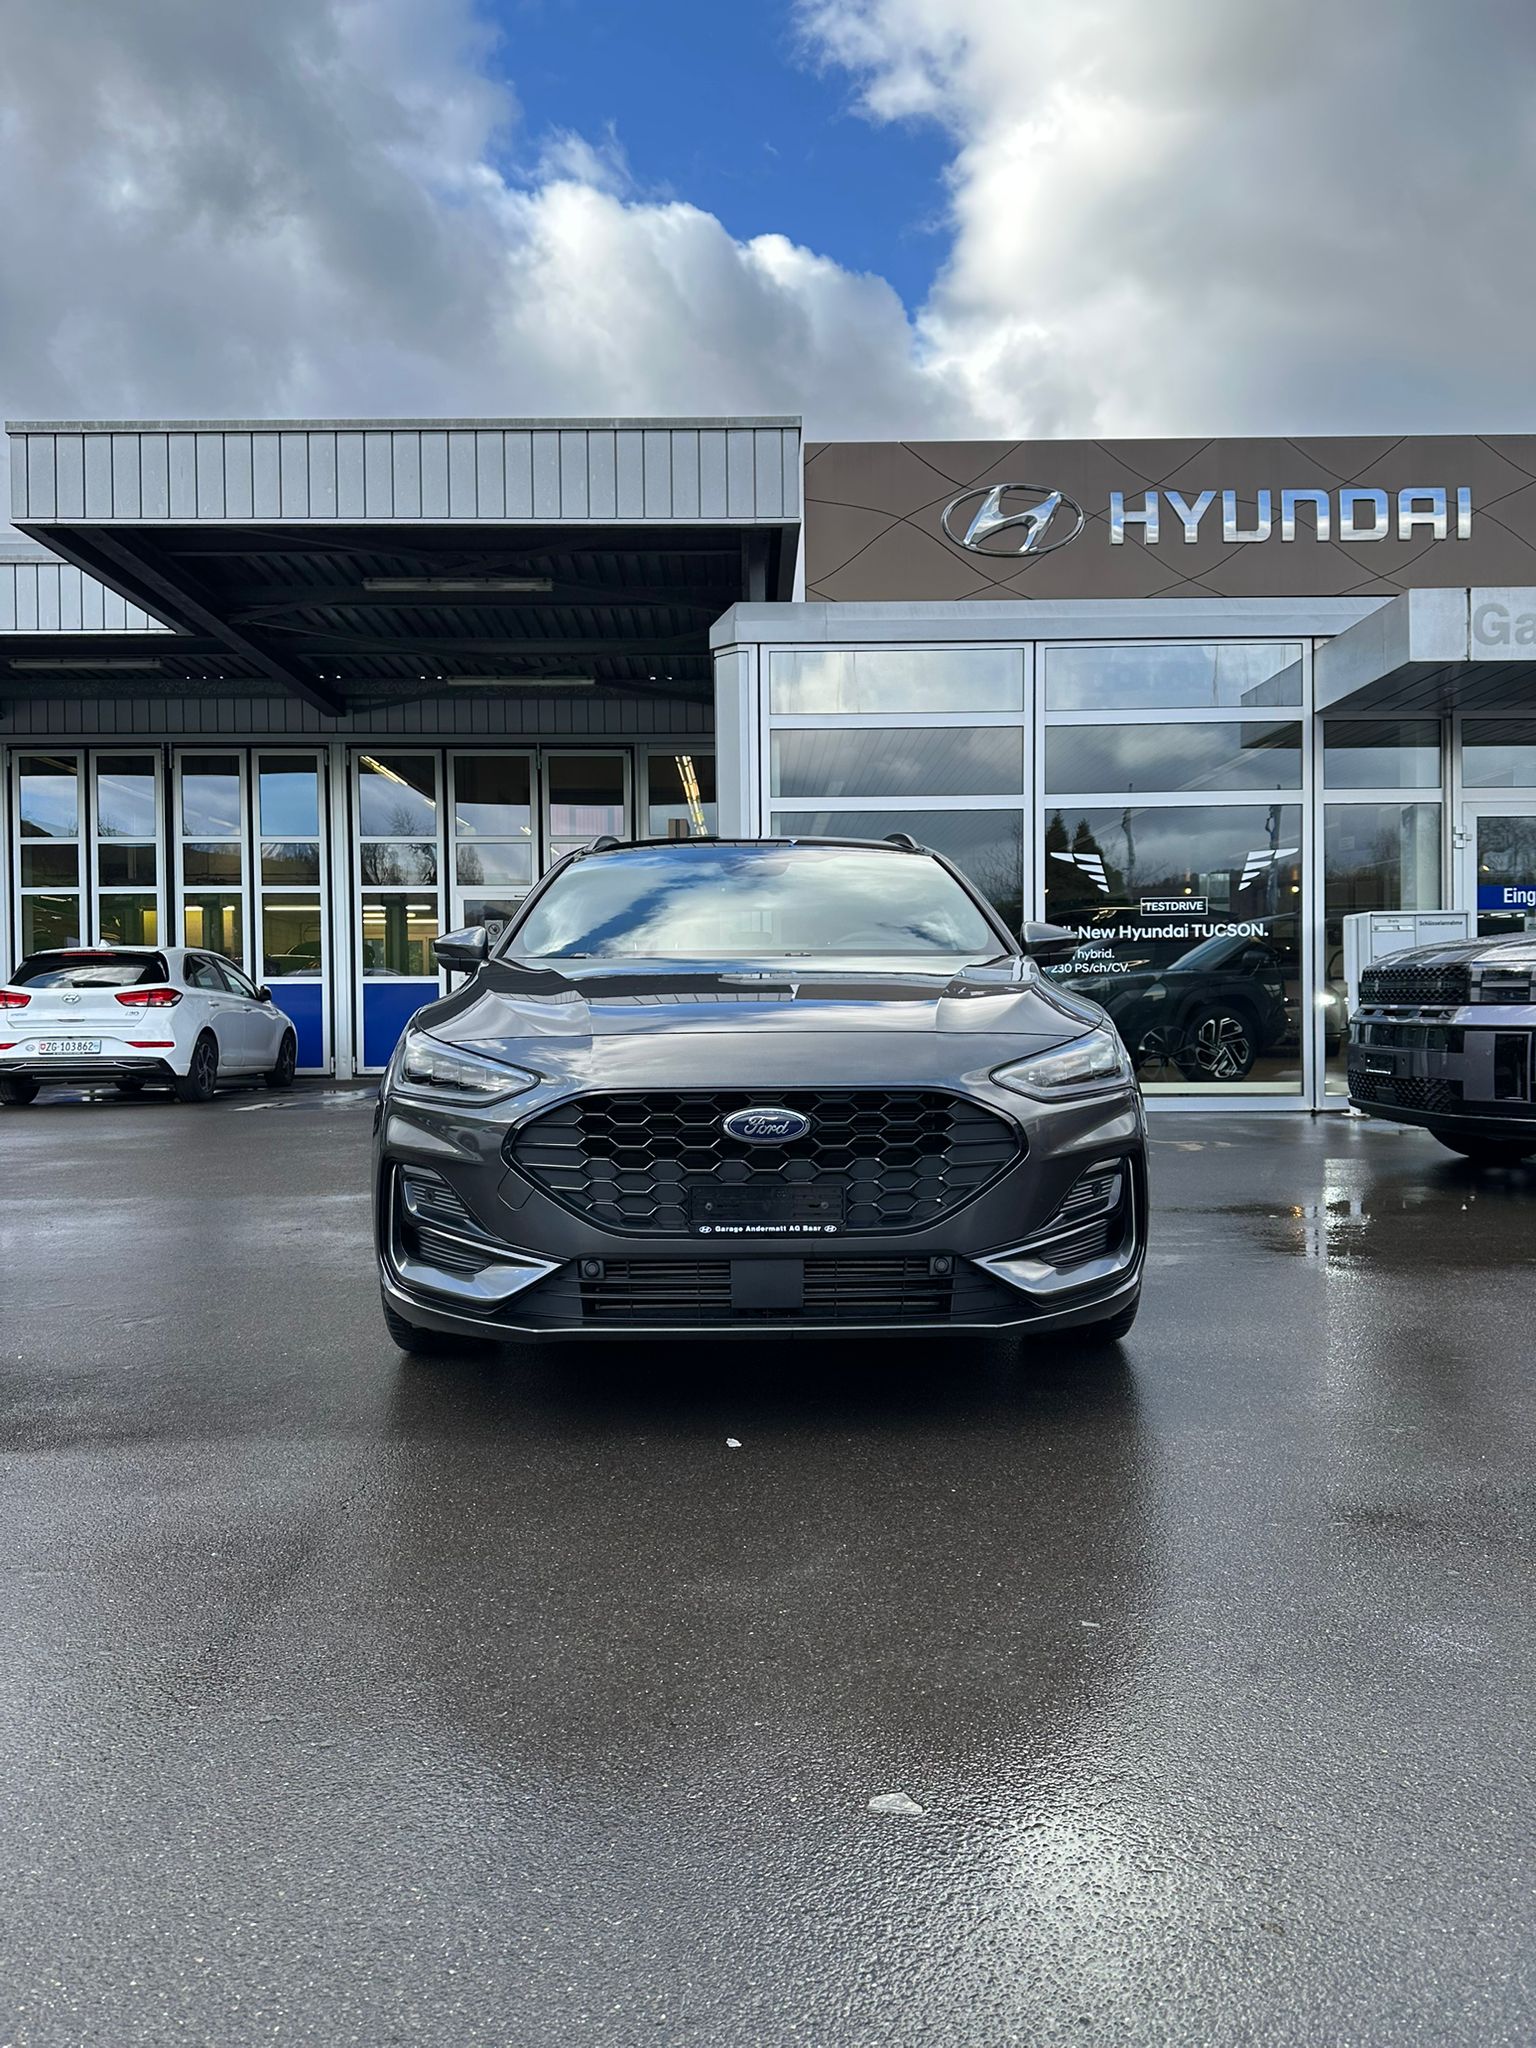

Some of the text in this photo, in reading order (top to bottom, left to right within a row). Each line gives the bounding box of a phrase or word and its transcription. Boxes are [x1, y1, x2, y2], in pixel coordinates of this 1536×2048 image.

[1109, 486, 1473, 545] HYUNDAI
[1503, 887, 1536, 907] Eing
[1145, 901, 1204, 912] TESTDRIVE
[1119, 924, 1189, 942] Hyundai
[1192, 923, 1269, 938] TUCSON.
[1077, 948, 1115, 961] hybrid.
[1051, 962, 1131, 974] 230 PS/ch/CV.
[743, 1115, 790, 1135] Ford
[714, 1225, 743, 1233] Garage
